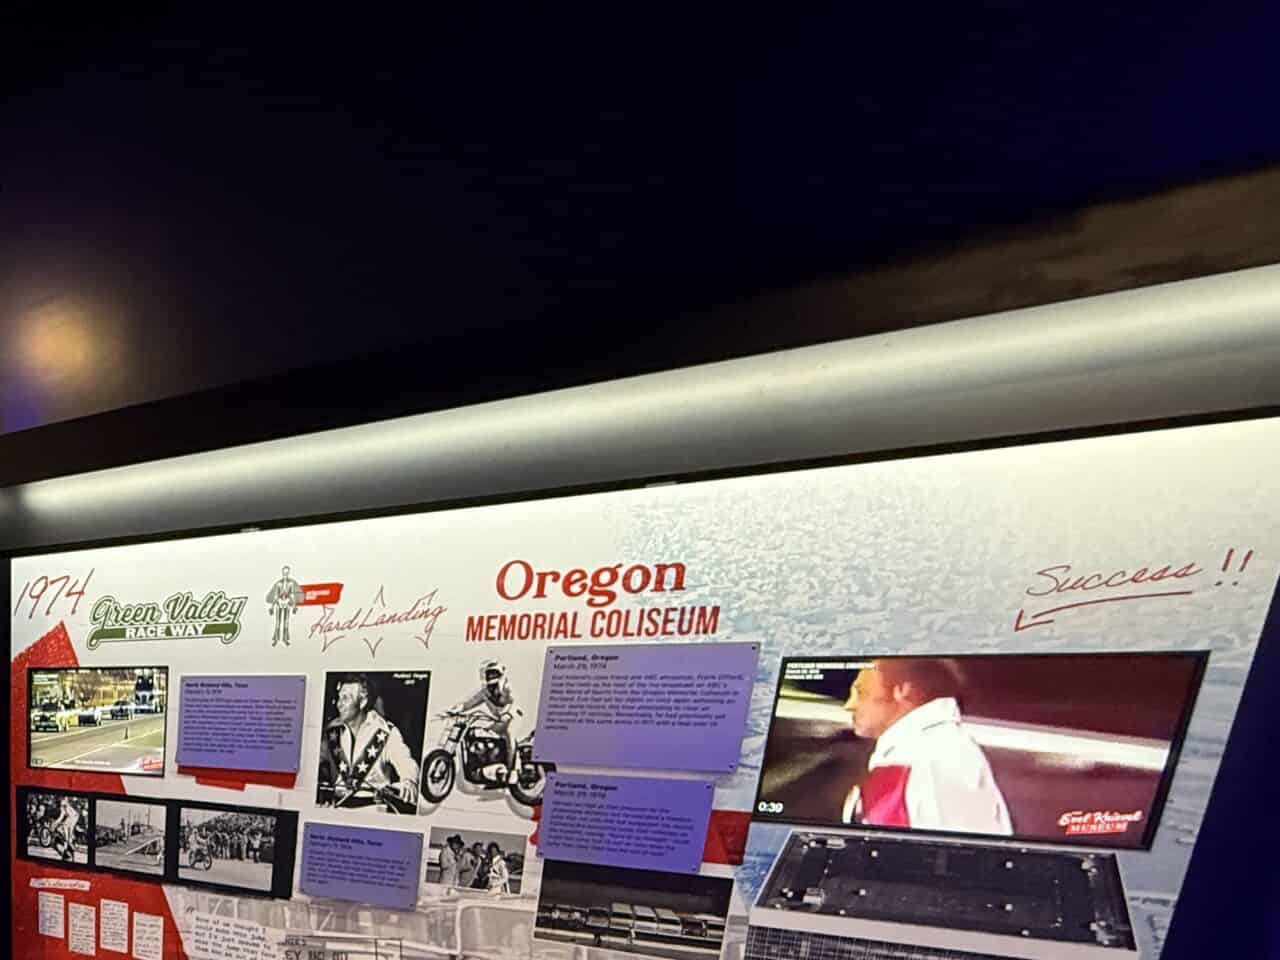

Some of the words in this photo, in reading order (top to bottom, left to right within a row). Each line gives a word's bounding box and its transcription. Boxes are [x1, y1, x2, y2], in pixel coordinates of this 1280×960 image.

[14, 568, 95, 619] 1974
[496, 560, 686, 607] Oregon
[1026, 563, 1203, 596] Success
[89, 595, 162, 630] Green
[164, 591, 249, 626] Valley
[465, 611, 582, 642] MEMORIAL
[590, 606, 721, 639] COLISEUM
[125, 625, 166, 639] RACE
[169, 624, 206, 637] WAY
